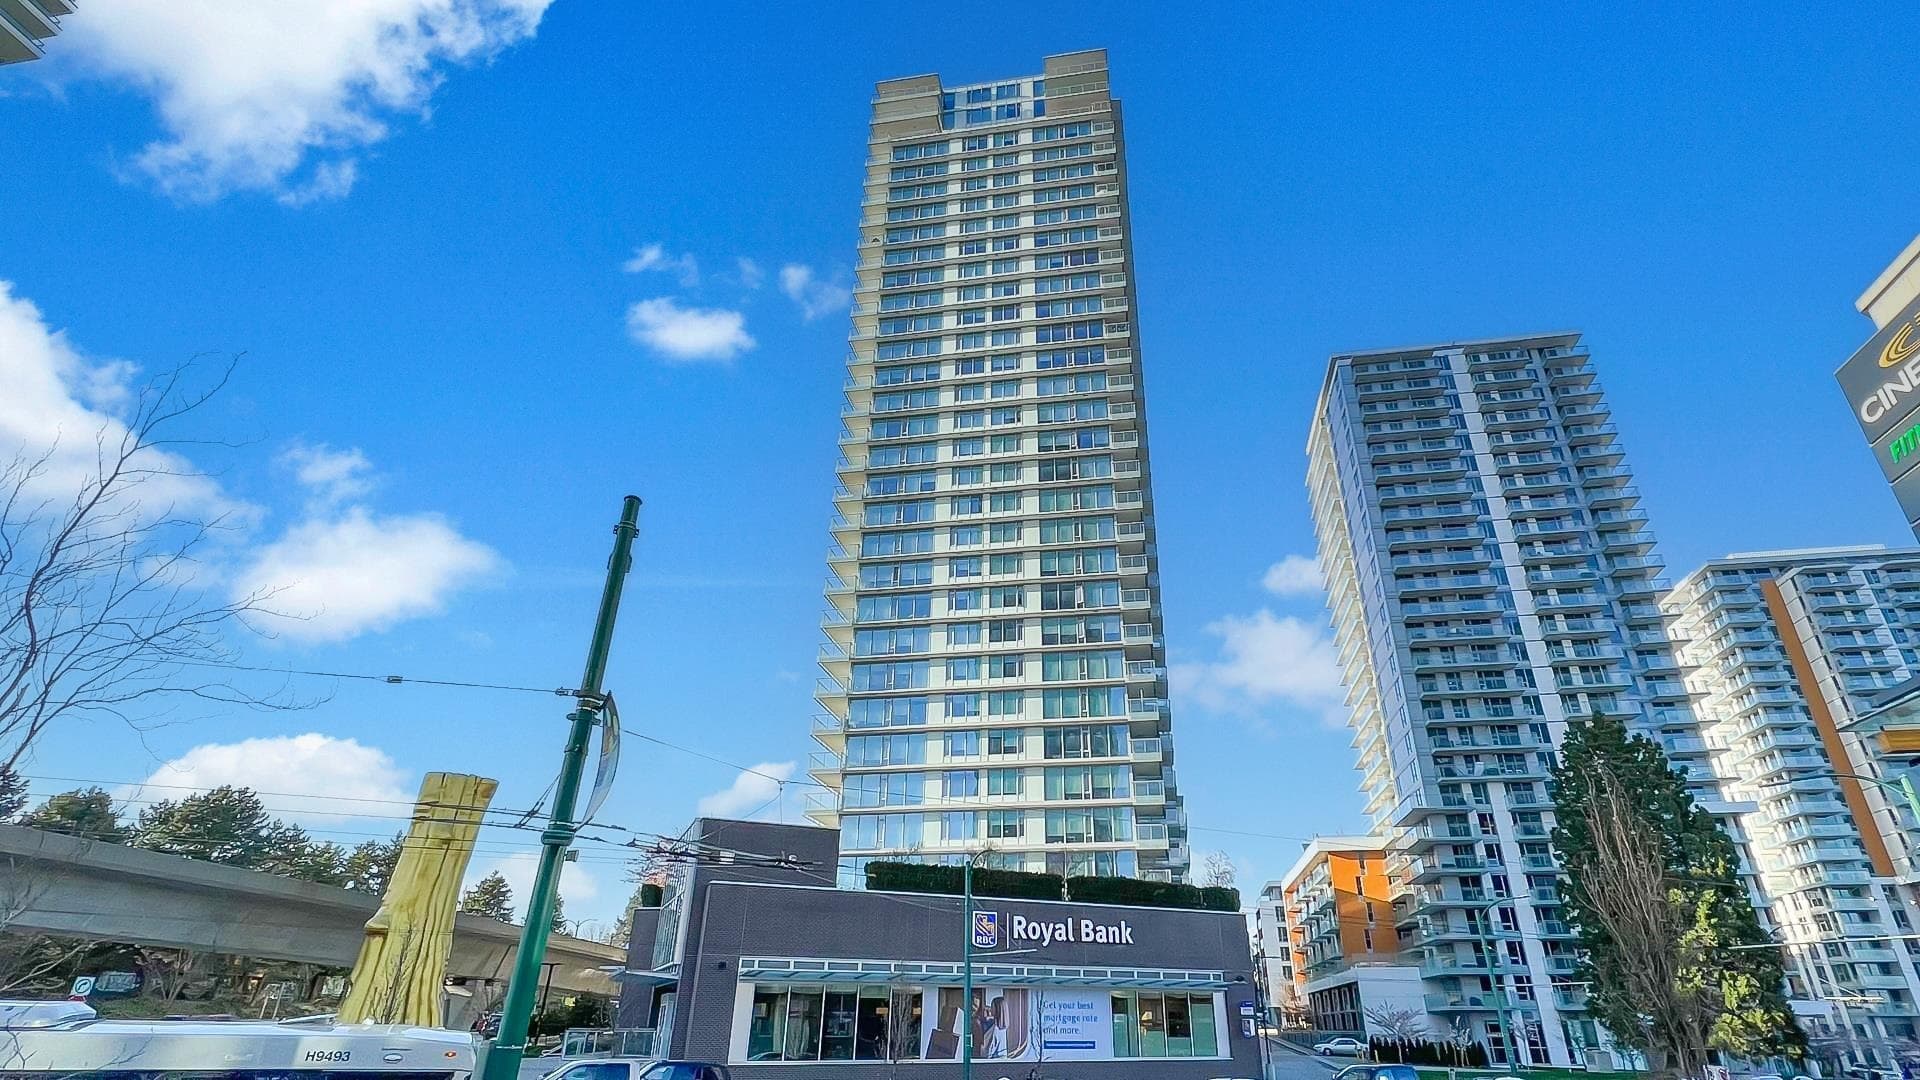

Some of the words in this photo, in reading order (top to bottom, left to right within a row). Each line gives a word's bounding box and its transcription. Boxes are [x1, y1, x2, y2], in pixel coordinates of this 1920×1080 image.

[1013, 915, 1075, 947] Royal
[1080, 919, 1134, 944] Bank
[976, 935, 994, 945] RBC
[1058, 1001, 1075, 1011] your
[1077, 1001, 1094, 1010] best
[1043, 1014, 1080, 1024] mortgage
[1043, 1026, 1058, 1035] and
[304, 1050, 351, 1062] H9493
